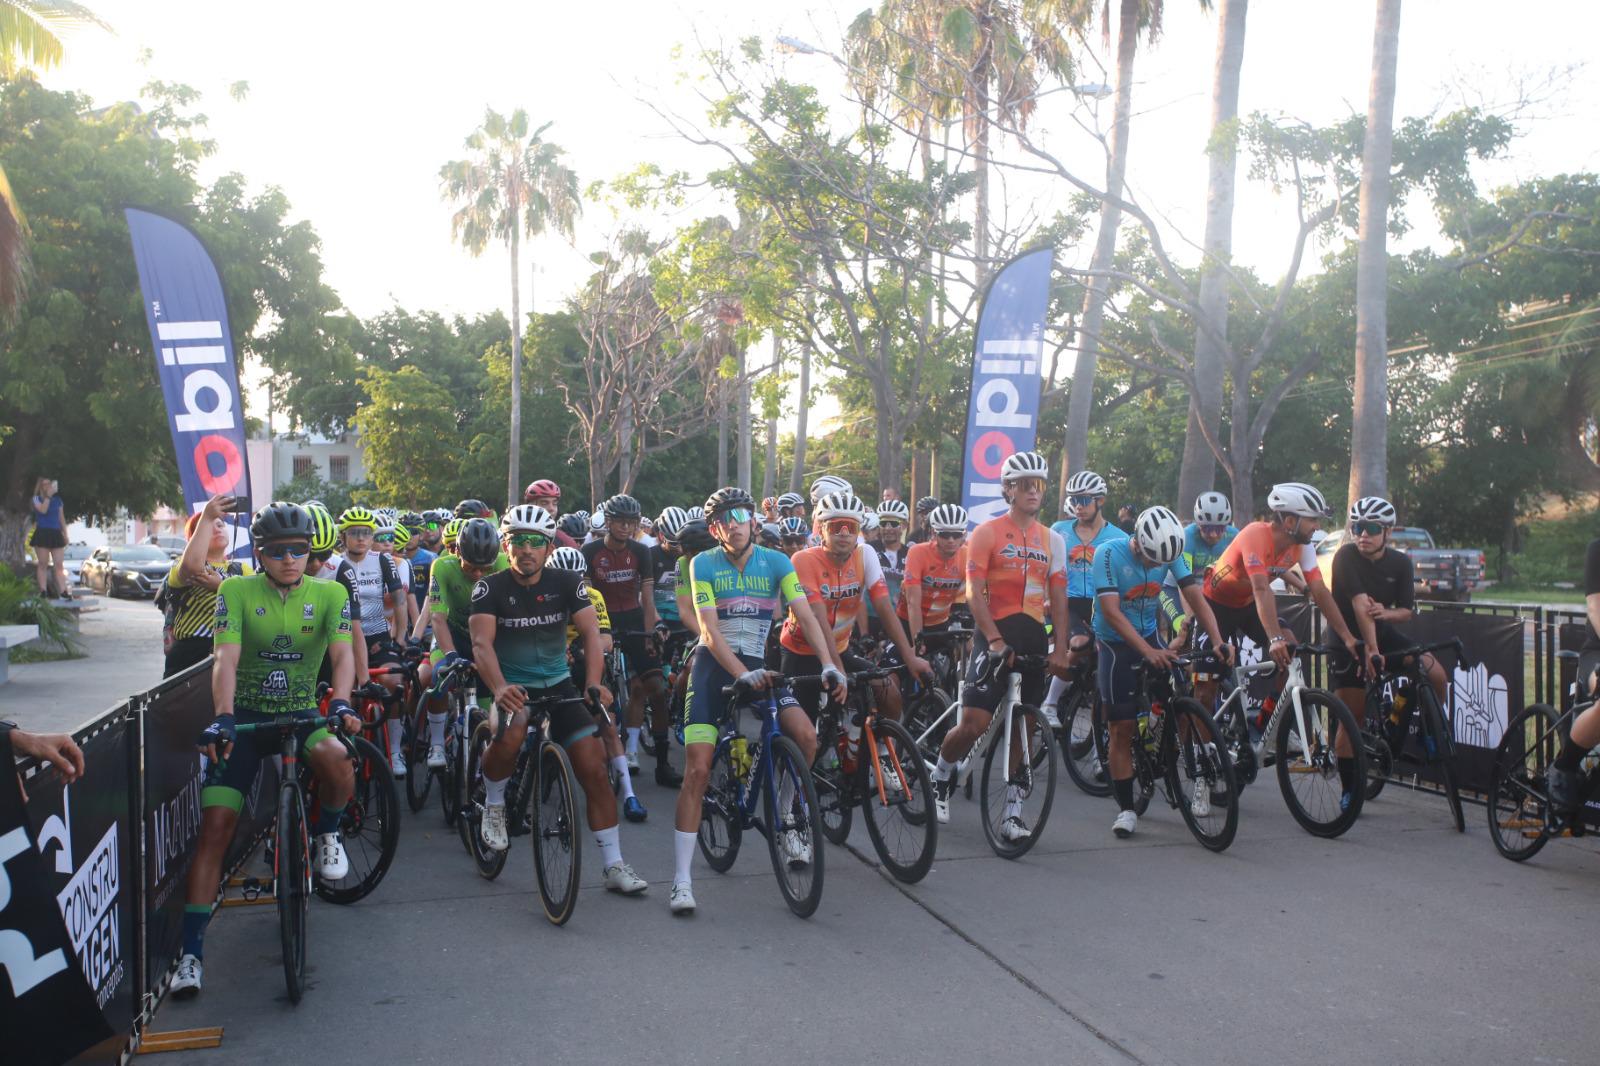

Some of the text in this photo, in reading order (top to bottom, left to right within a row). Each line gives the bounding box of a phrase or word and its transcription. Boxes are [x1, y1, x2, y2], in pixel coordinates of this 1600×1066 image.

[714, 573, 771, 593] ONE 4 NINE
[497, 612, 565, 628] PETROLIKE
